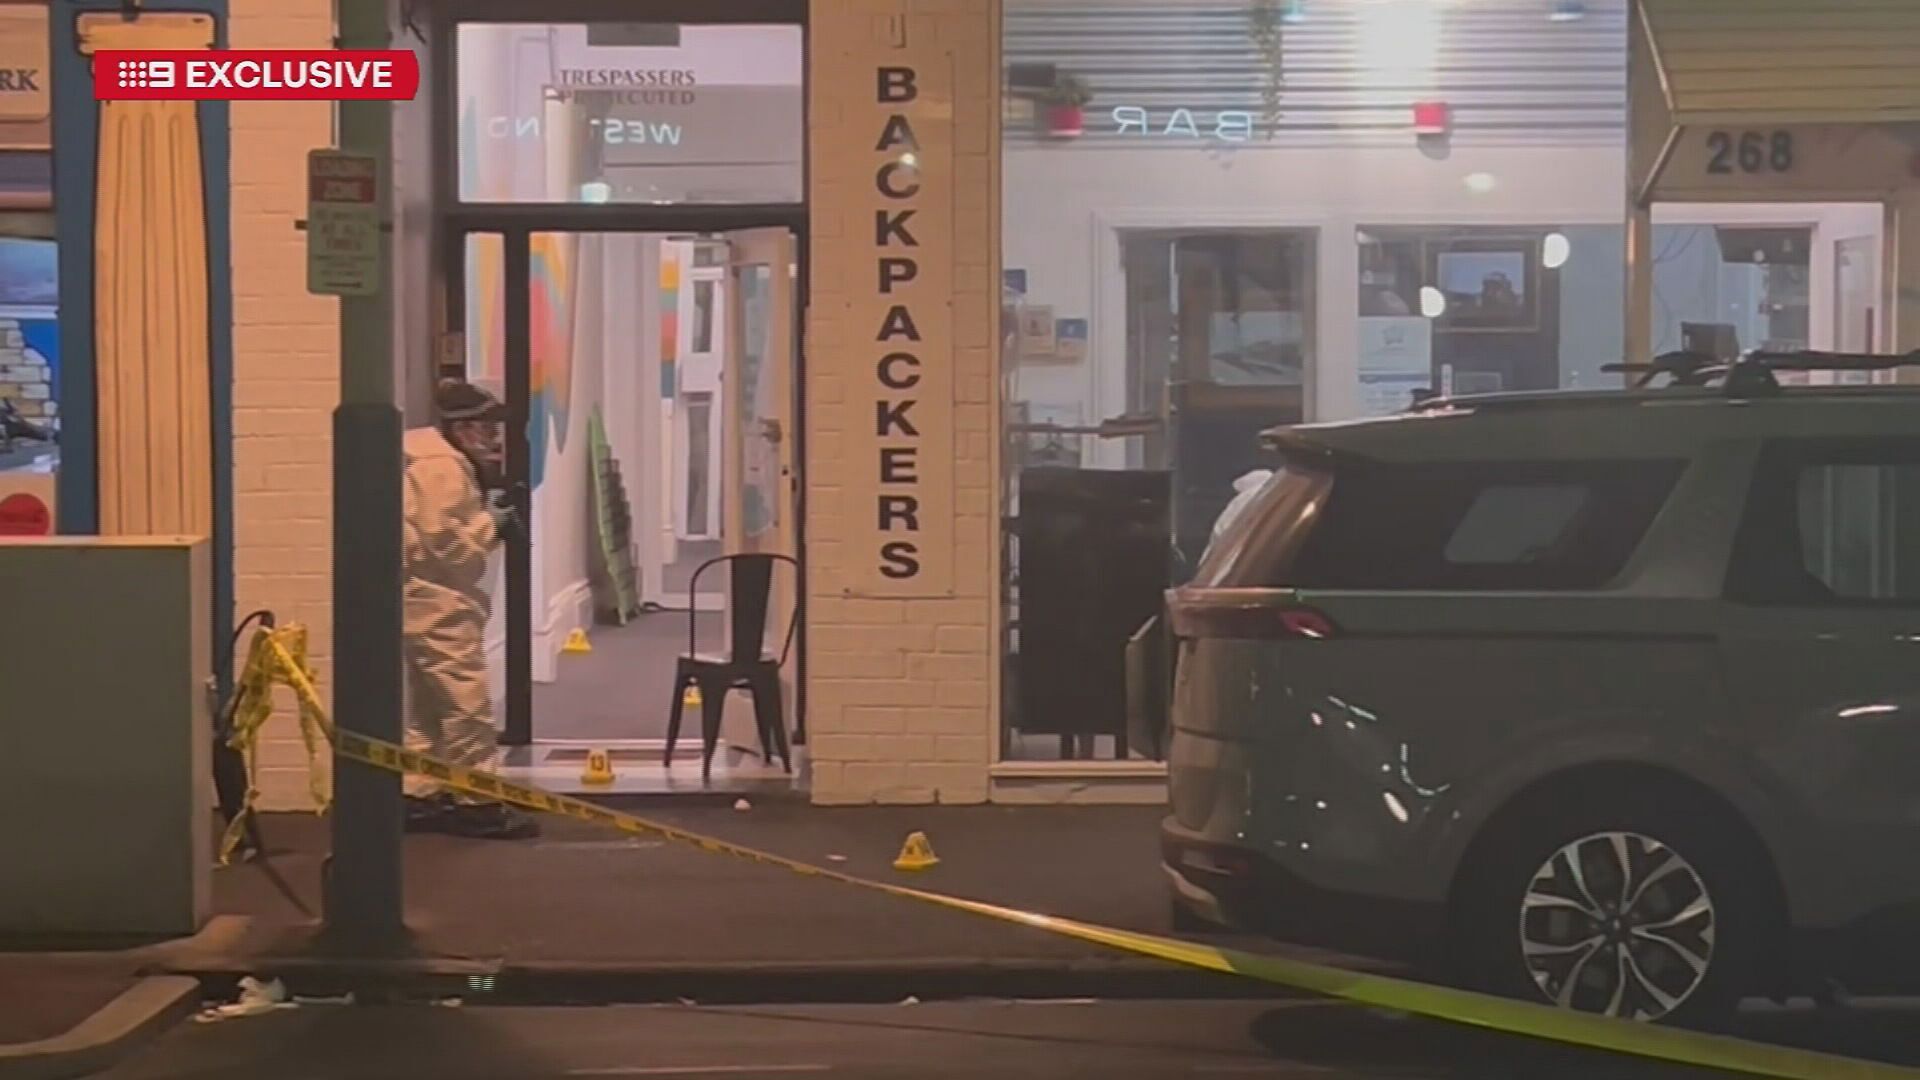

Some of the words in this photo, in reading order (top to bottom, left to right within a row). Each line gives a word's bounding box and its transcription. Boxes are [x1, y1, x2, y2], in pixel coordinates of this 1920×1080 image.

[558, 69, 696, 85] TRESPASSERS
[1705, 130, 1793, 174] 268
[874, 66, 920, 579] BACKPACKERS
[590, 755, 605, 772] 13
